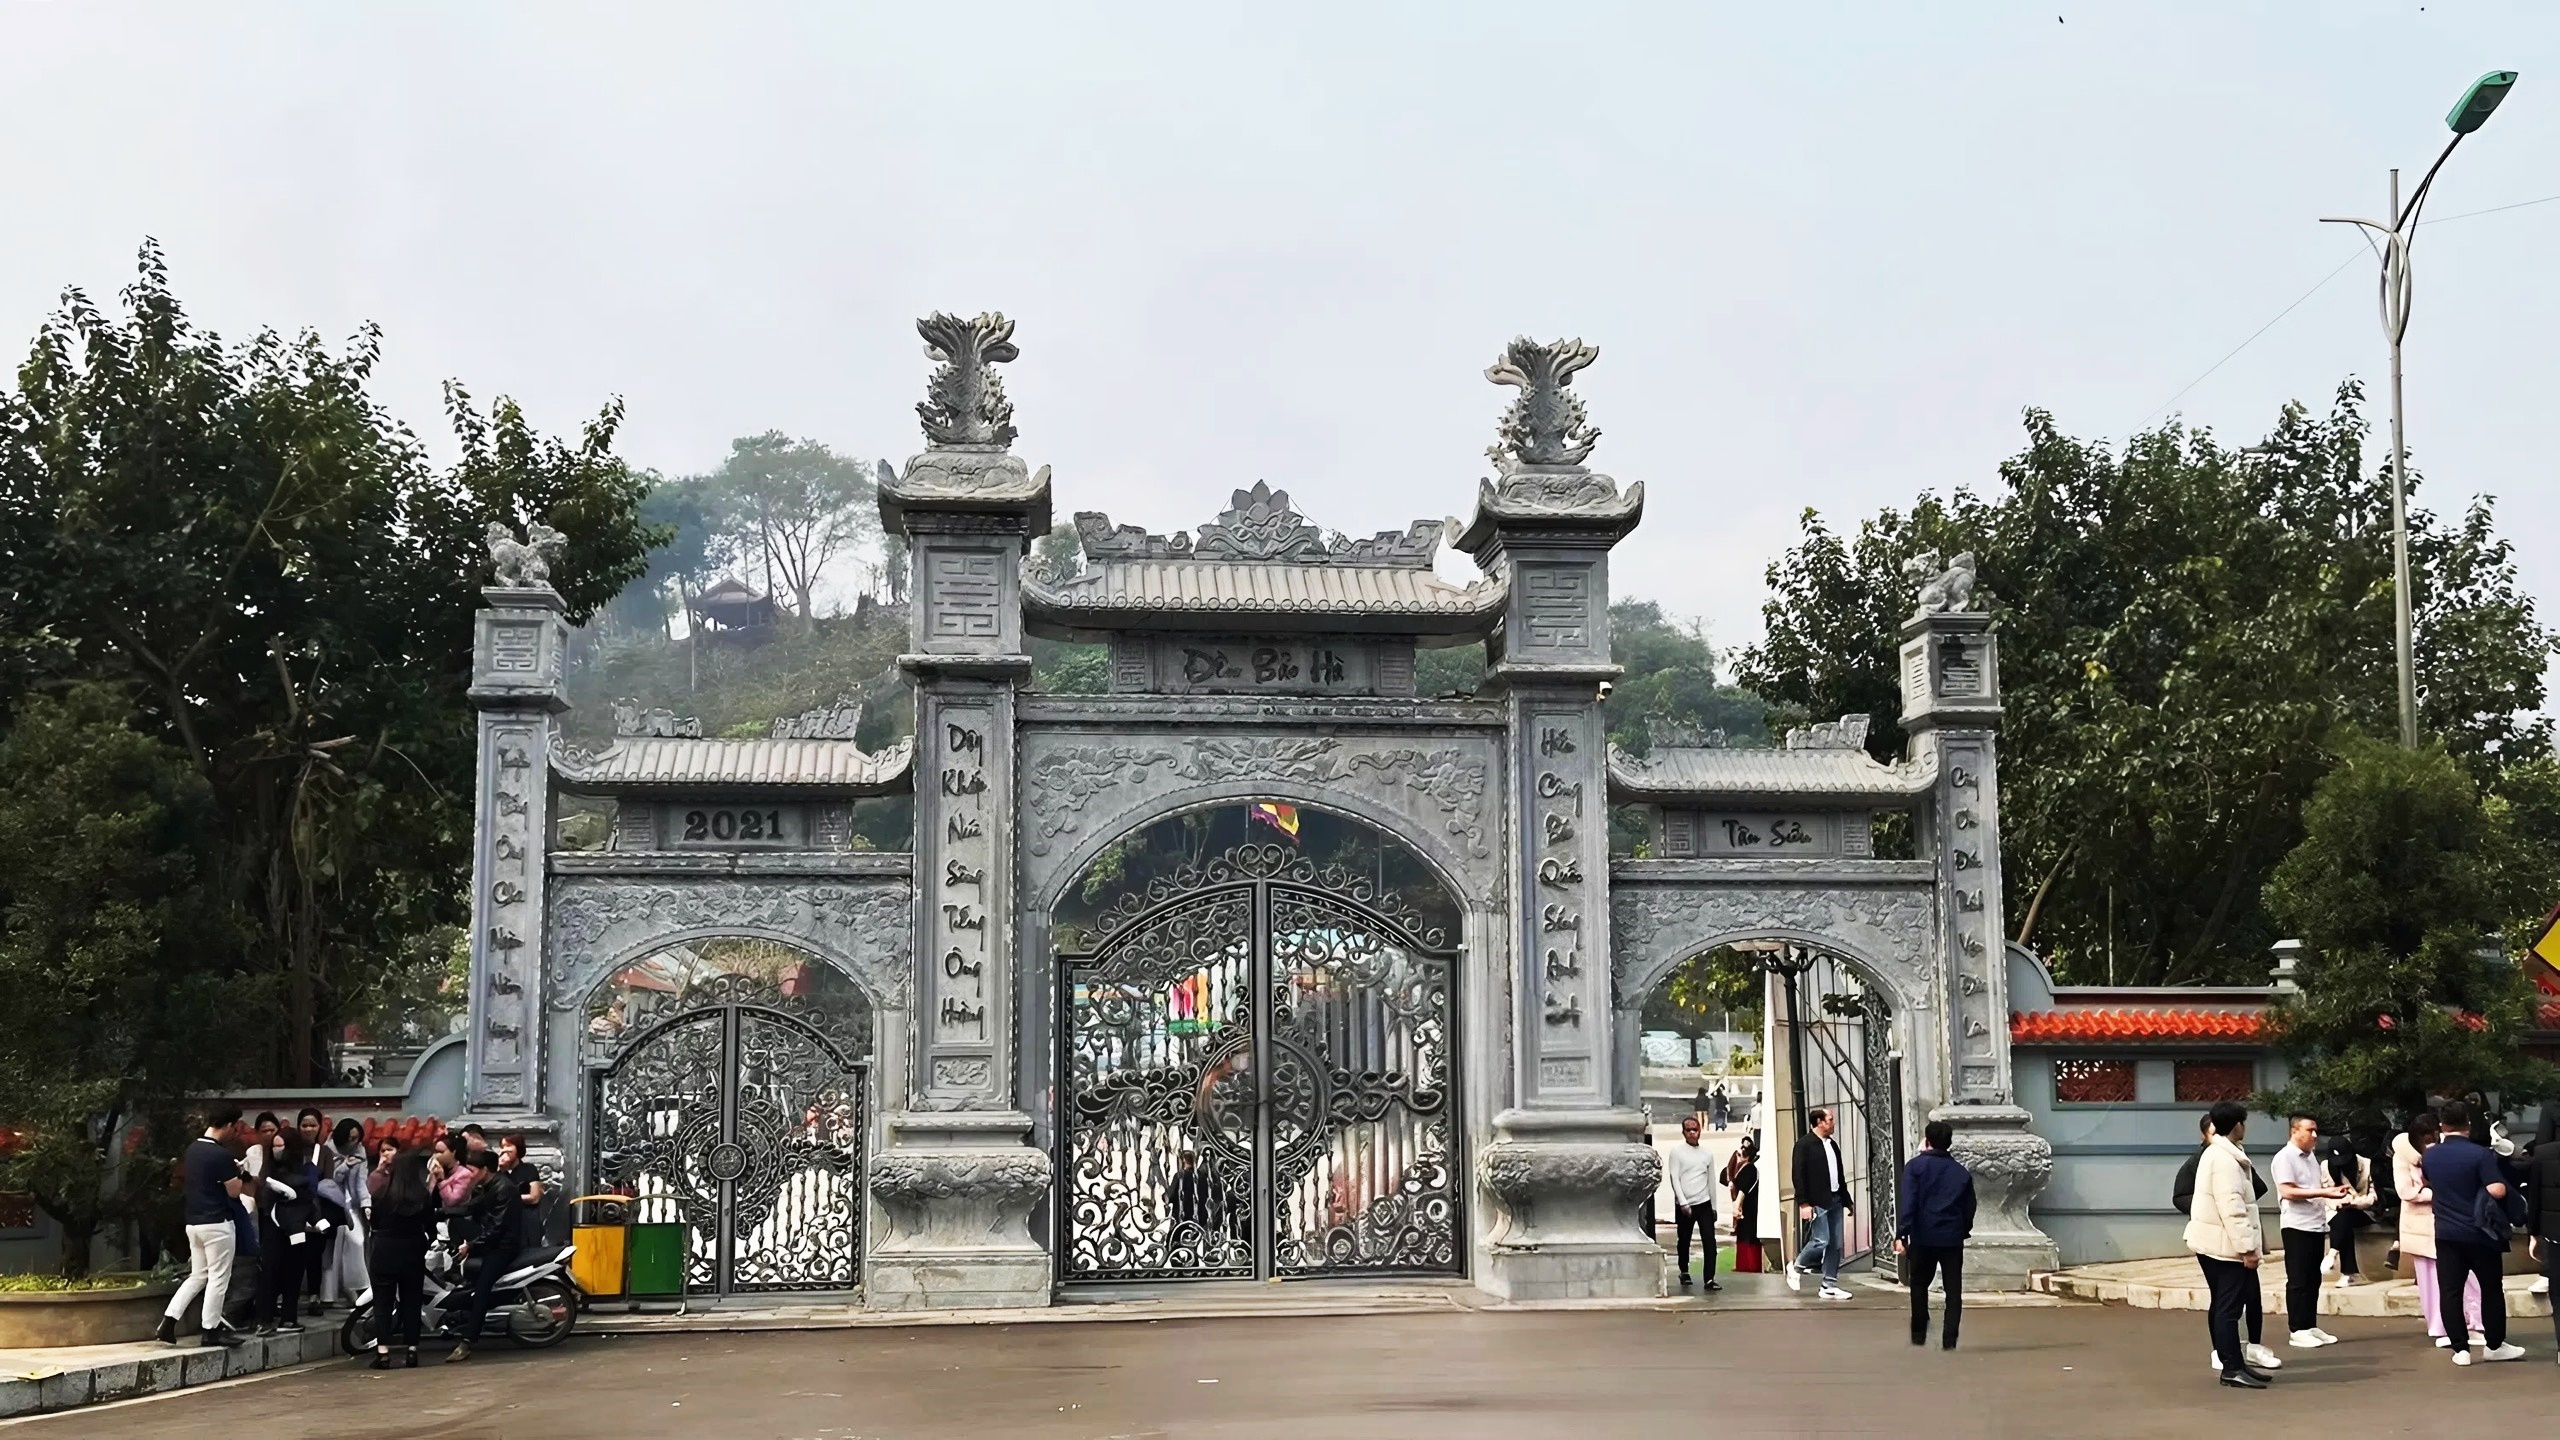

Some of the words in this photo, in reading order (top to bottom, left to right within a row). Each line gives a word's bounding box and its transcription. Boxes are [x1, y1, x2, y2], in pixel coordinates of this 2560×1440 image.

[1310, 650, 1345, 686] Hà
[683, 809, 784, 841] 2021
[1722, 819, 1761, 848] Tân
